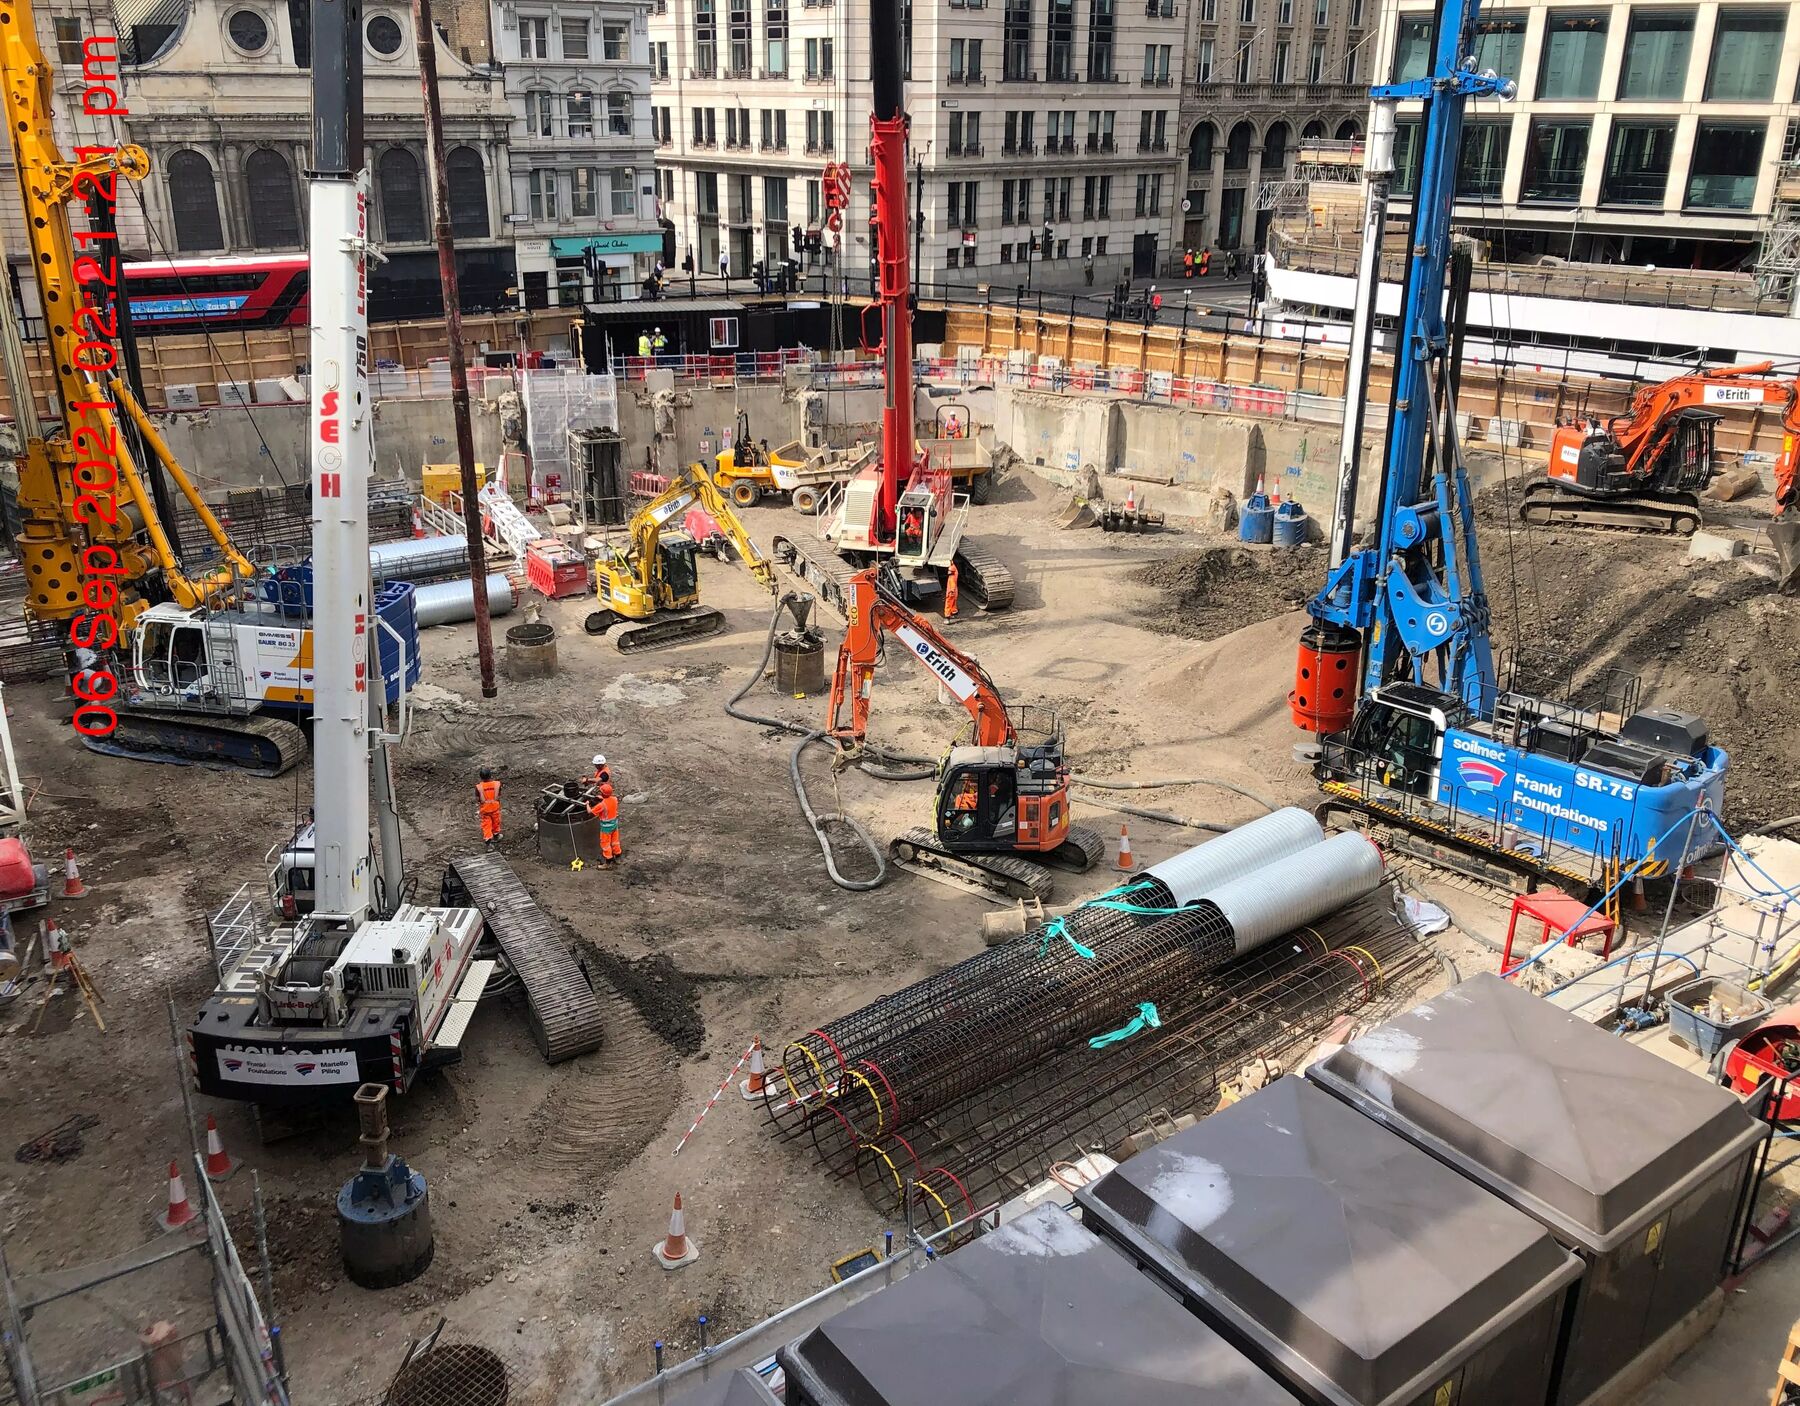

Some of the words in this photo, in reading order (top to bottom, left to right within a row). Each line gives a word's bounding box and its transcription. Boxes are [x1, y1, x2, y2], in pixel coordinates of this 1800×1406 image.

[356, 191, 366, 316] Link-elt
[1725, 388, 1750, 400] Erith
[924, 649, 957, 682] Erith
[1453, 737, 1506, 762] soilmec
[1515, 773, 1562, 799] Franki
[1575, 773, 1633, 801] SR-75
[1513, 792, 1608, 832] Foundations
[247, 1068, 287, 1076] Foundations
